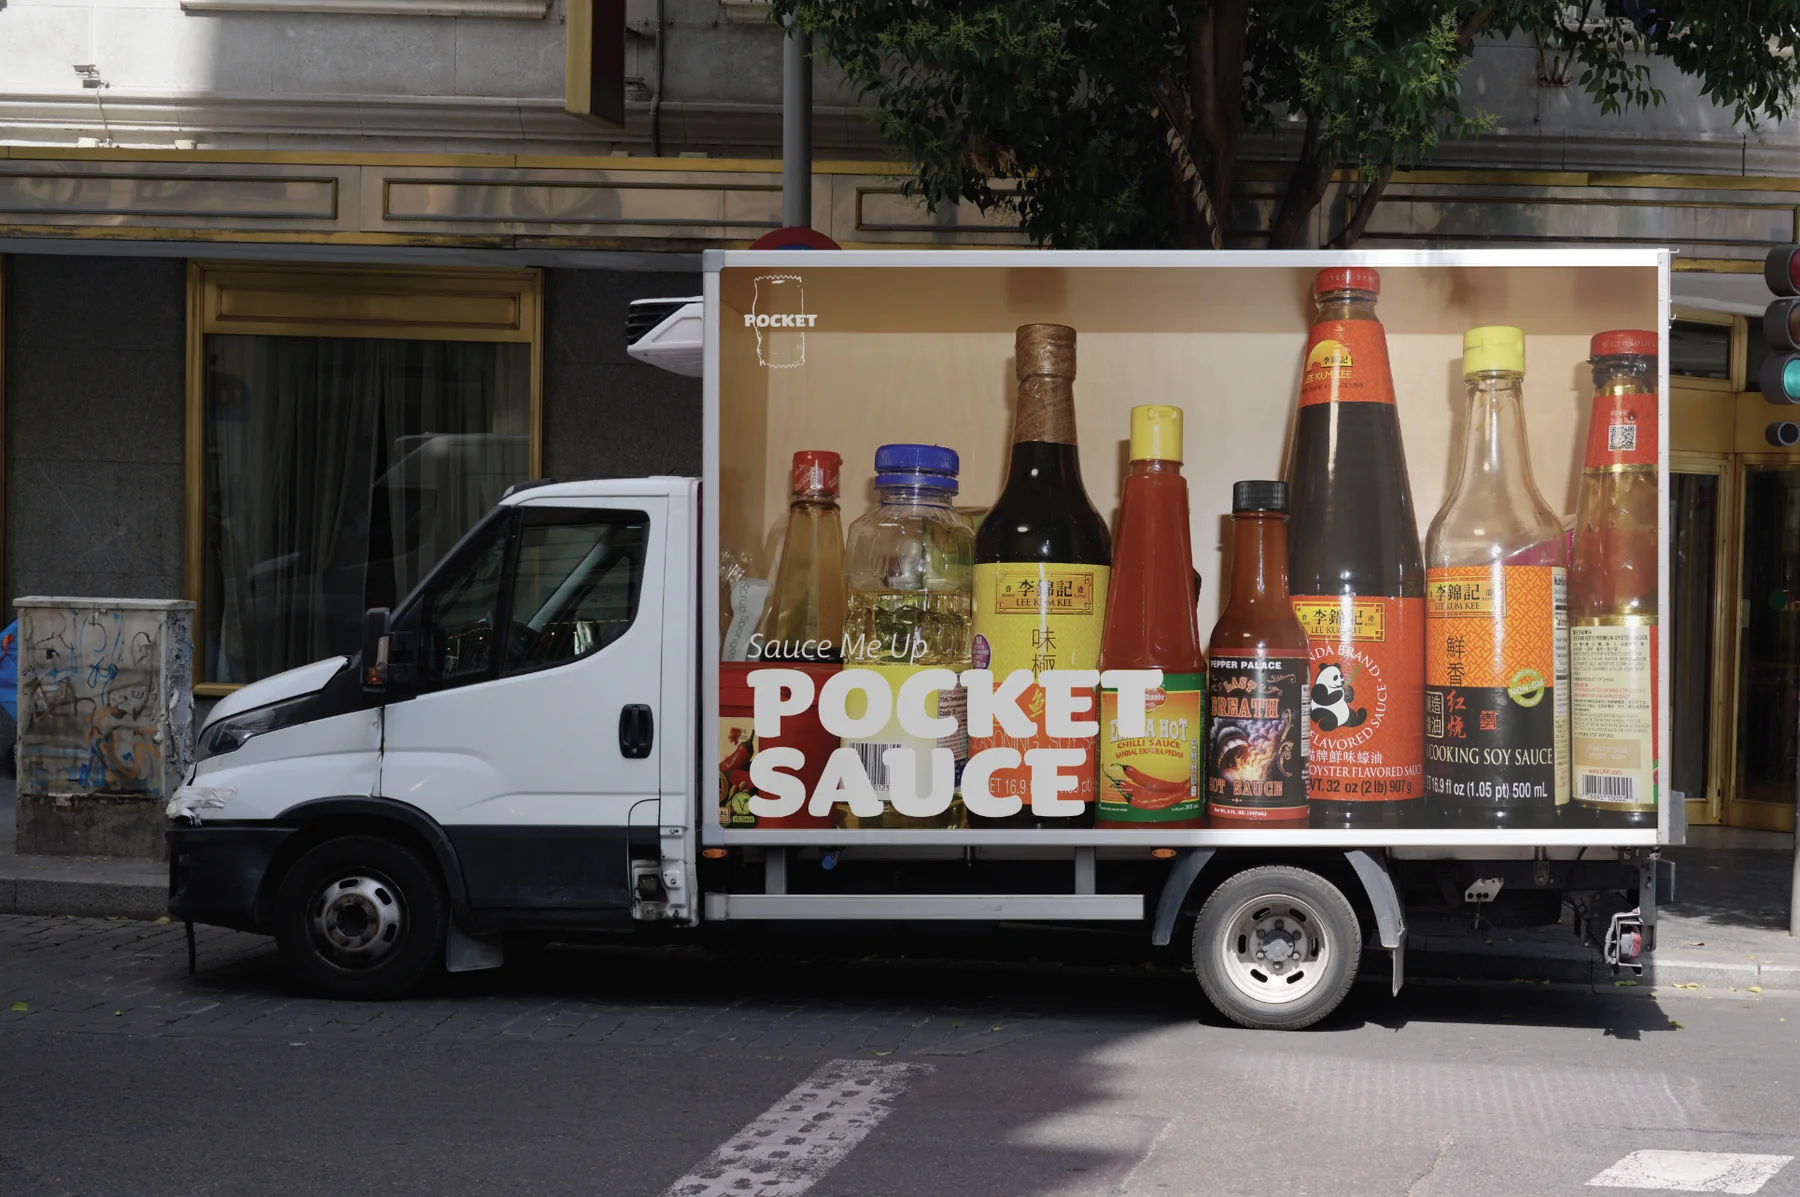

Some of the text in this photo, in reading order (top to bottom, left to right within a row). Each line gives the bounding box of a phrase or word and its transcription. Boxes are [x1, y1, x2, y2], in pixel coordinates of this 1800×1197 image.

[743, 313, 818, 328] POCKET
[739, 581, 750, 614] Scrub
[1435, 583, 1480, 602] 李錦記
[1016, 598, 1073, 607] LEE KM KEE
[1445, 602, 1464, 611] KUM
[1465, 601, 1481, 610] KEE
[1311, 626, 1324, 634] LEE
[747, 632, 929, 666] Sauce Me Up
[1210, 660, 1282, 670] PEPPER PALACE
[1309, 644, 1380, 677] NDA BRAND
[1446, 635, 1466, 686] 鮮香
[1223, 676, 1257, 693] LAST
[746, 667, 1165, 739] POCKET
[1210, 696, 1280, 719] BREATH
[1370, 683, 1388, 729] SAUCE
[1159, 717, 1189, 742] HOT
[1117, 738, 1181, 749] CHILLI SAUCE
[1115, 747, 1184, 760] SAMBAL EKSTRA PEDAS
[1429, 743, 1553, 766] COOKING SOY SAUCE
[1309, 764, 1423, 778] OYSTER FLAVORED SAUCE
[748, 746, 1087, 818] SAUCE
[988, 777, 1027, 796] ET 16.9
[1232, 780, 1284, 797] SAUCE
[1326, 779, 1341, 793] 32
[1344, 781, 1358, 793] oz
[1360, 780, 1372, 796] (2
[1373, 780, 1388, 796] lb)
[1431, 774, 1445, 793] 16.9
[1445, 778, 1452, 795] fl
[1453, 783, 1465, 796] oz
[1466, 780, 1492, 798] (1.05
[1495, 782, 1510, 802] pt)
[1512, 781, 1532, 798] 500
[1533, 781, 1548, 798] mL
[734, 815, 756, 823] VEGAN
